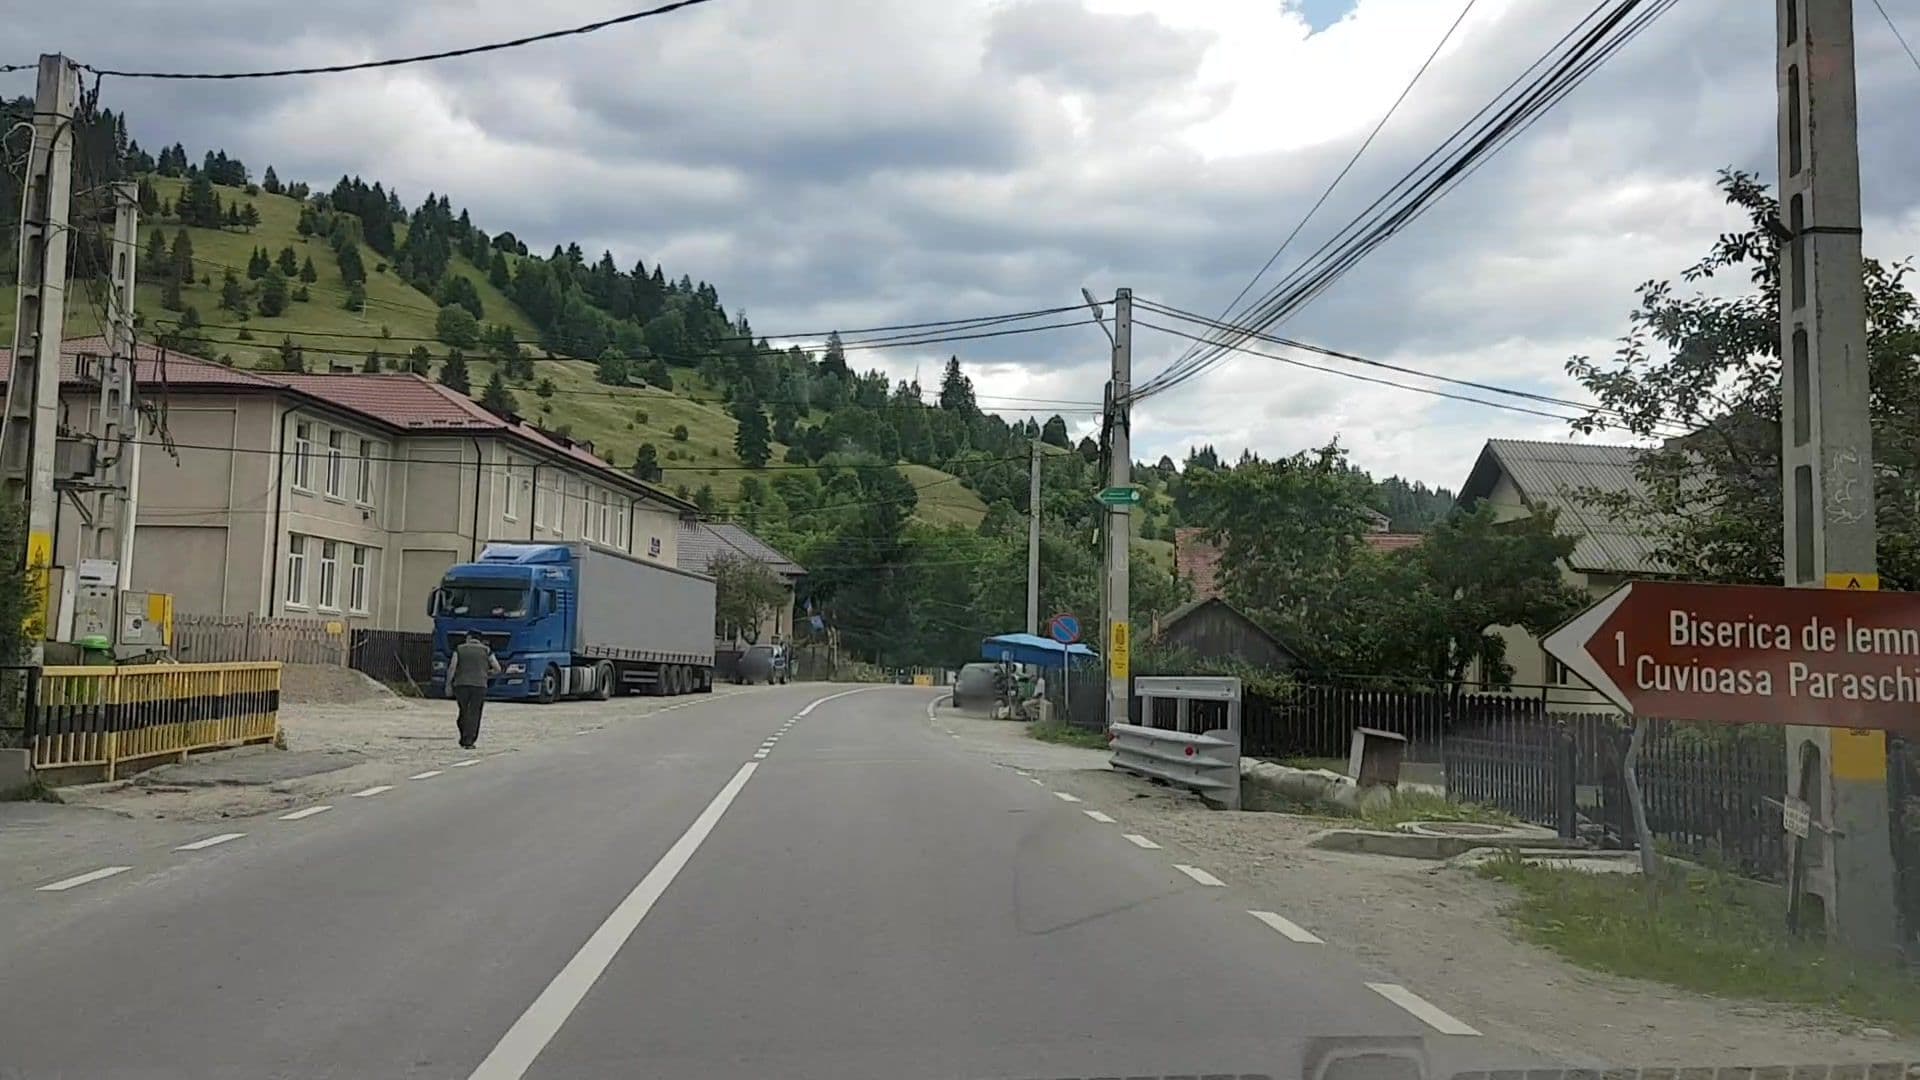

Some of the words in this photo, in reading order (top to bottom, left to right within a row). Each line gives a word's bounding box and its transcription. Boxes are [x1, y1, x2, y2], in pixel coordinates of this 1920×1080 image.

[1614, 630, 1626, 666] 1
[1669, 610, 1791, 650] Biserica
[1802, 616, 1835, 651] de
[1846, 617, 1919, 655] lemn
[1636, 655, 1772, 696] Cuvioasa
